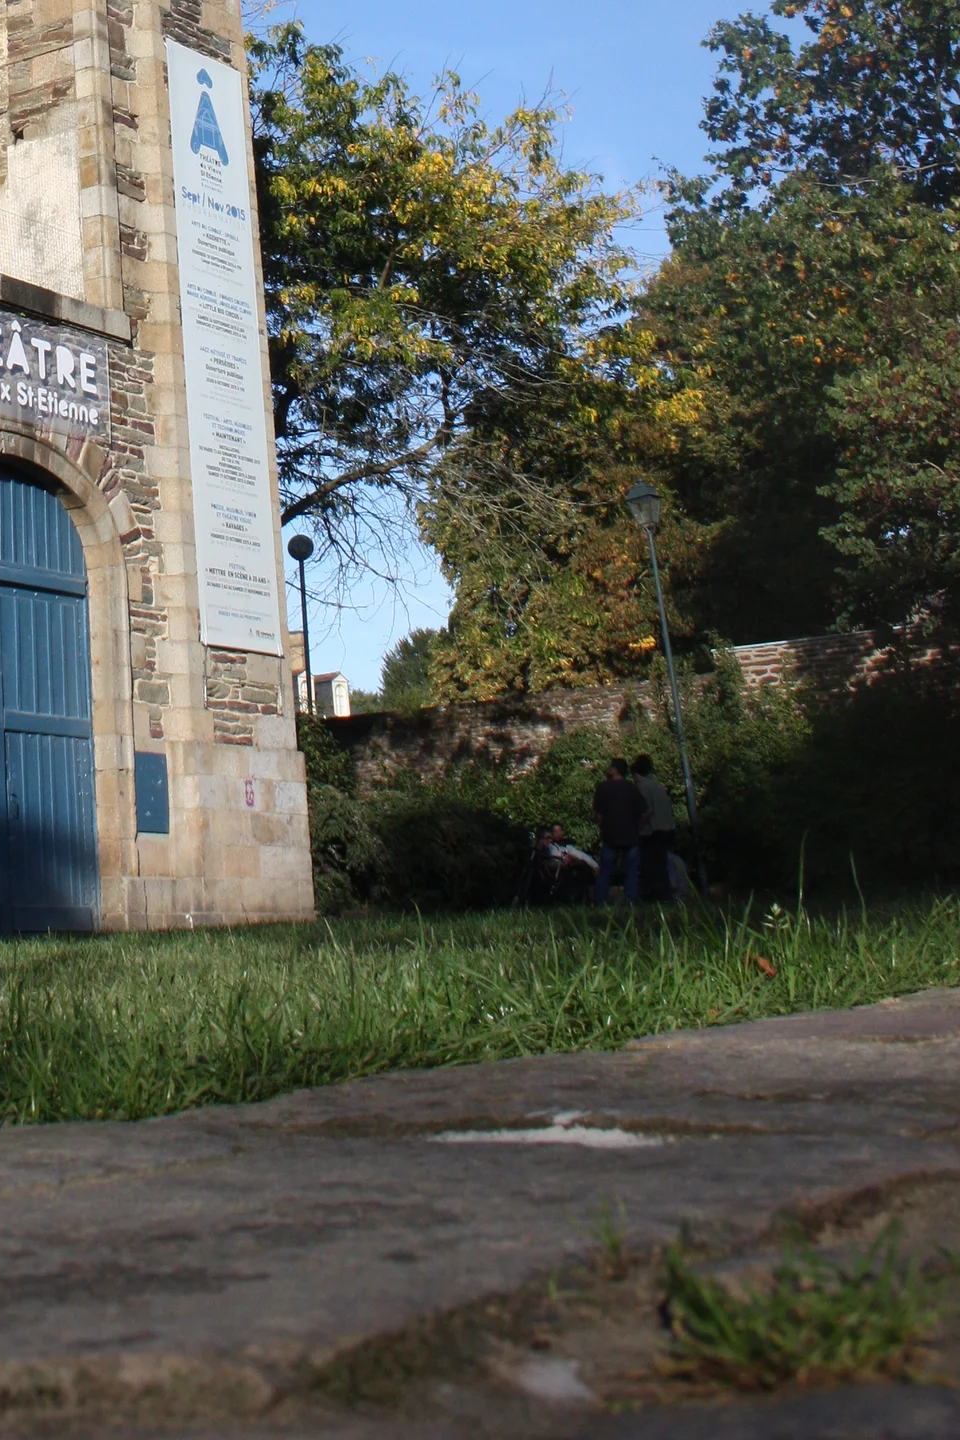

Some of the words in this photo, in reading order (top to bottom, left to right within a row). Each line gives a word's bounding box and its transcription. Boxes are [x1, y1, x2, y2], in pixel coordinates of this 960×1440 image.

[182, 186, 201, 207] Sept
[208, 196, 225, 213] Nov
[226, 203, 246, 222] 2015
[203, 303, 217, 312] LITTLE
[225, 311, 239, 320] CIRCUS
[216, 431, 243, 444] MAINTENANT
[226, 522, 245, 532] RAVAGES
[209, 567, 226, 577] METTRE
[235, 571, 248, 581] SCÈNE
